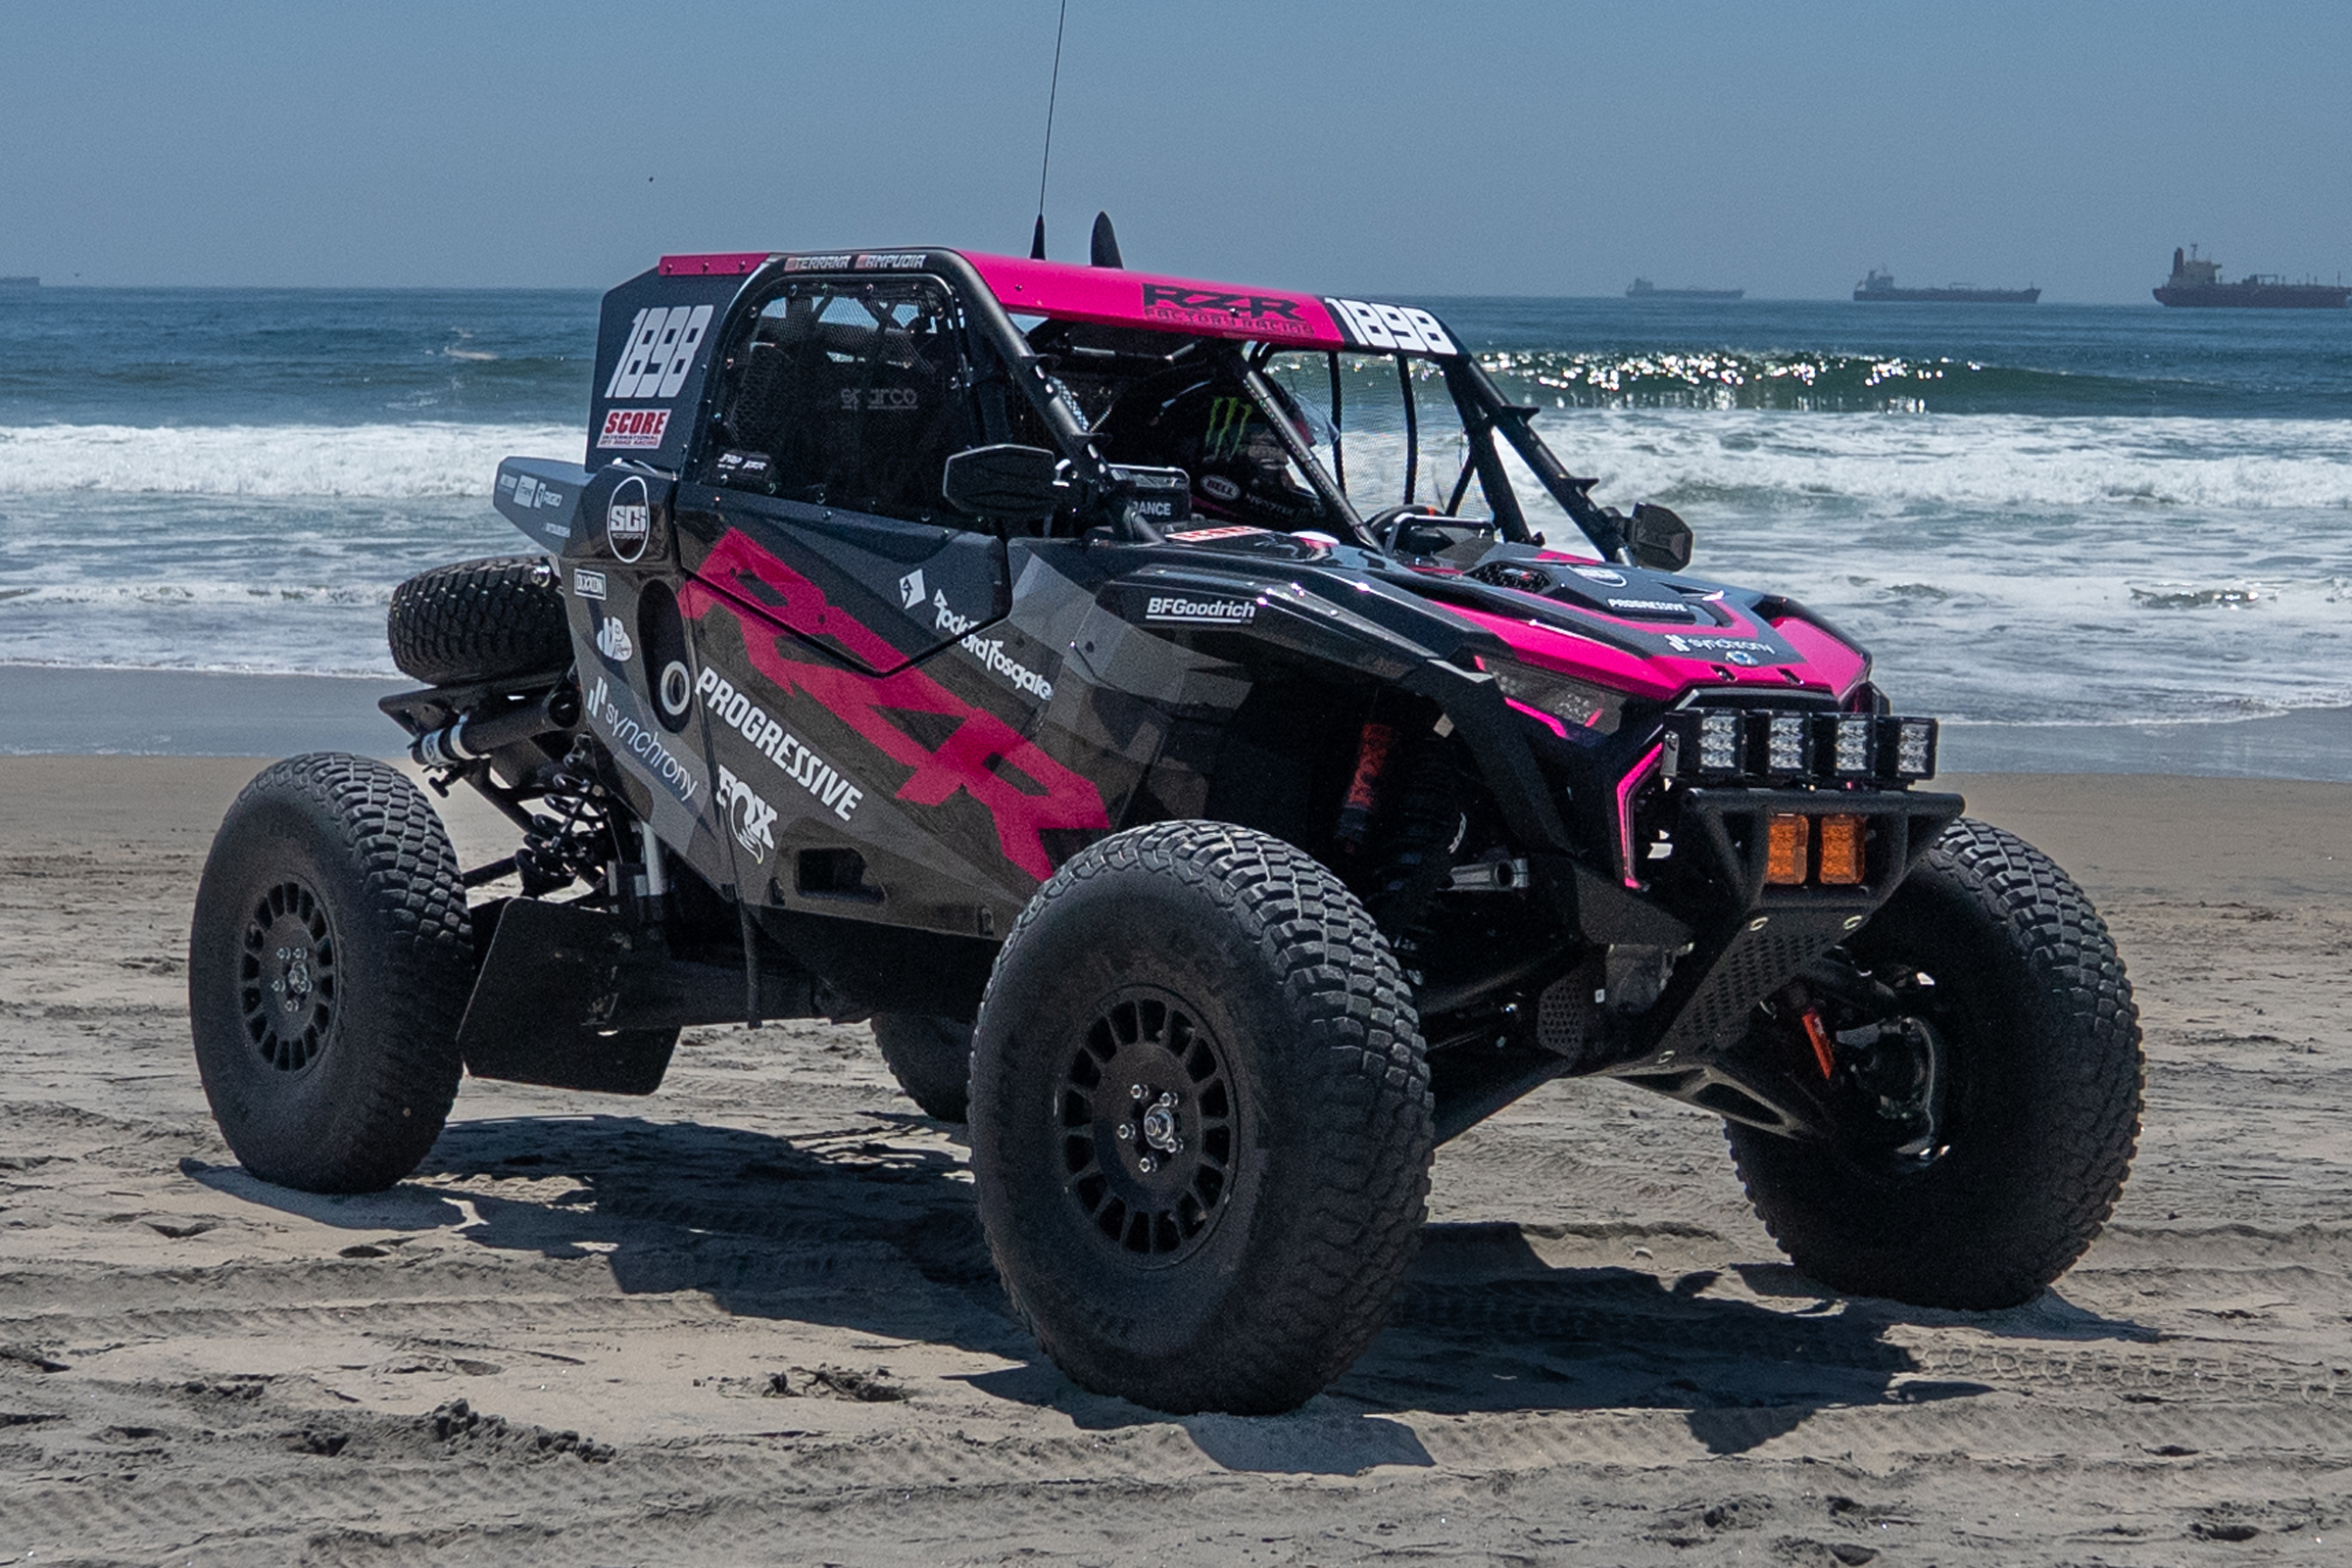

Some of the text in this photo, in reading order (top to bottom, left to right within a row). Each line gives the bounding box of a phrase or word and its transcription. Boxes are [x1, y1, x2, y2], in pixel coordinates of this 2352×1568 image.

[1143, 284, 1305, 321] RZR
[1324, 297, 1458, 356] 1898
[604, 304, 714, 399] 1898
[604, 412, 667, 434] SCORE
[1147, 597, 1256, 618] BFGoodrich
[1607, 598, 1689, 612] PROGRESSIVE
[1687, 637, 1777, 656] synchrony
[605, 703, 698, 802] synchrony
[695, 666, 863, 821] PROGRESSIVE
[716, 764, 778, 864] FOX
